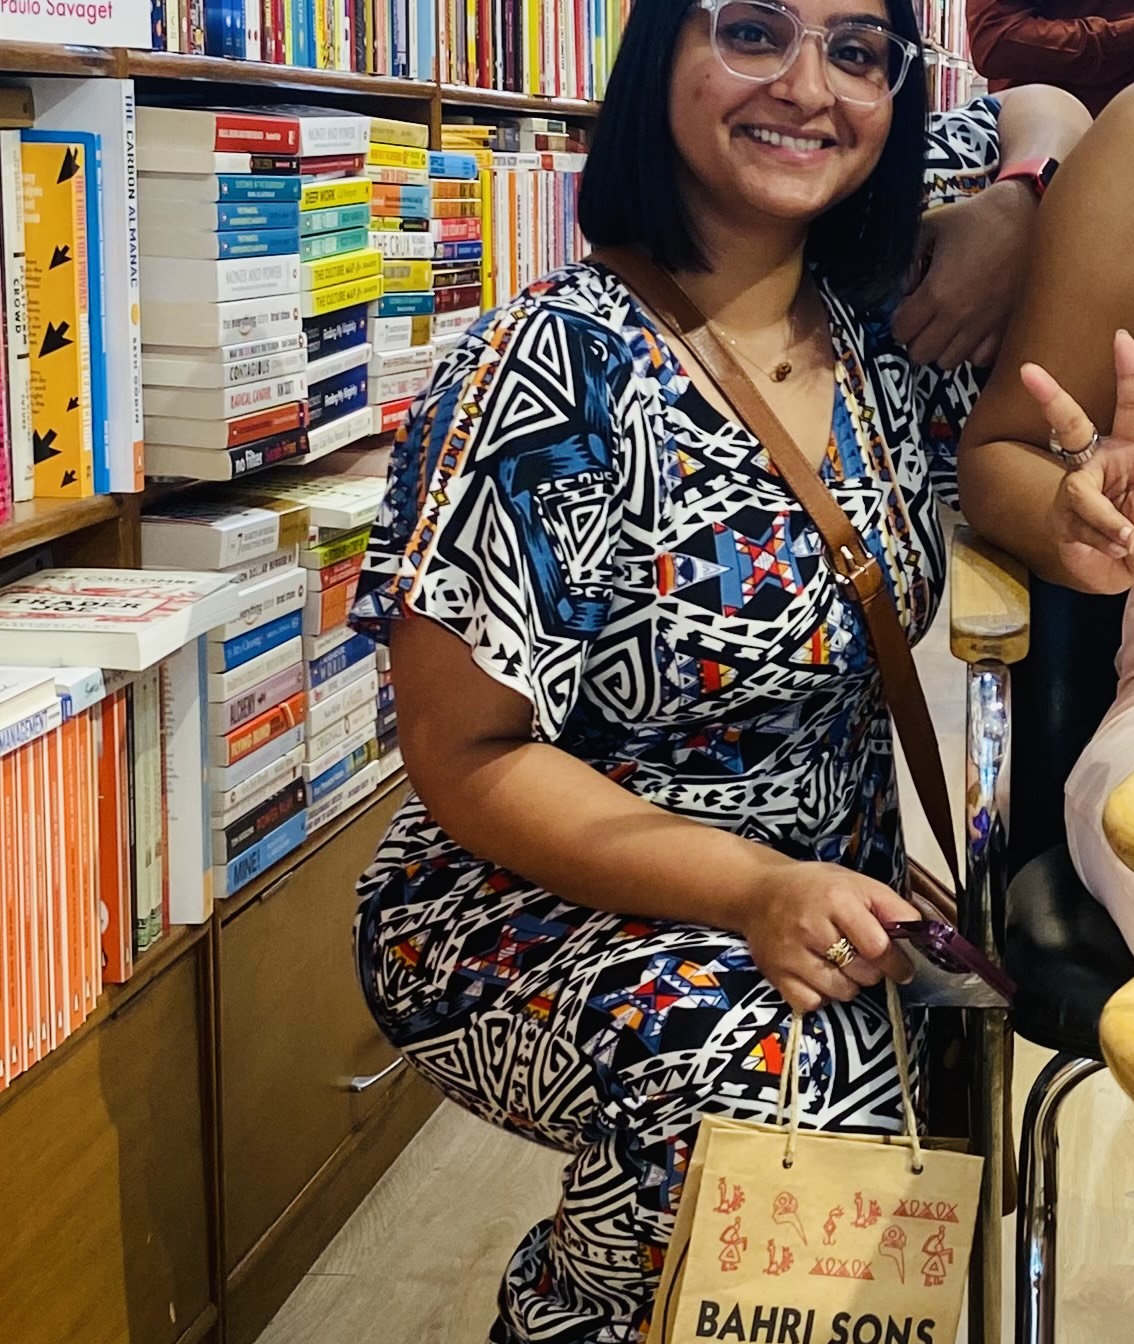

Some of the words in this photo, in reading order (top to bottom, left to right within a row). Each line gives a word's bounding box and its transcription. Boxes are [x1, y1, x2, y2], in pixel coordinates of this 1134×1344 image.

[125, 94, 134, 124] THE
[126, 129, 136, 200] CARBON
[128, 206, 139, 288] ALMANAC
[13, 279, 21, 333] CROWD
